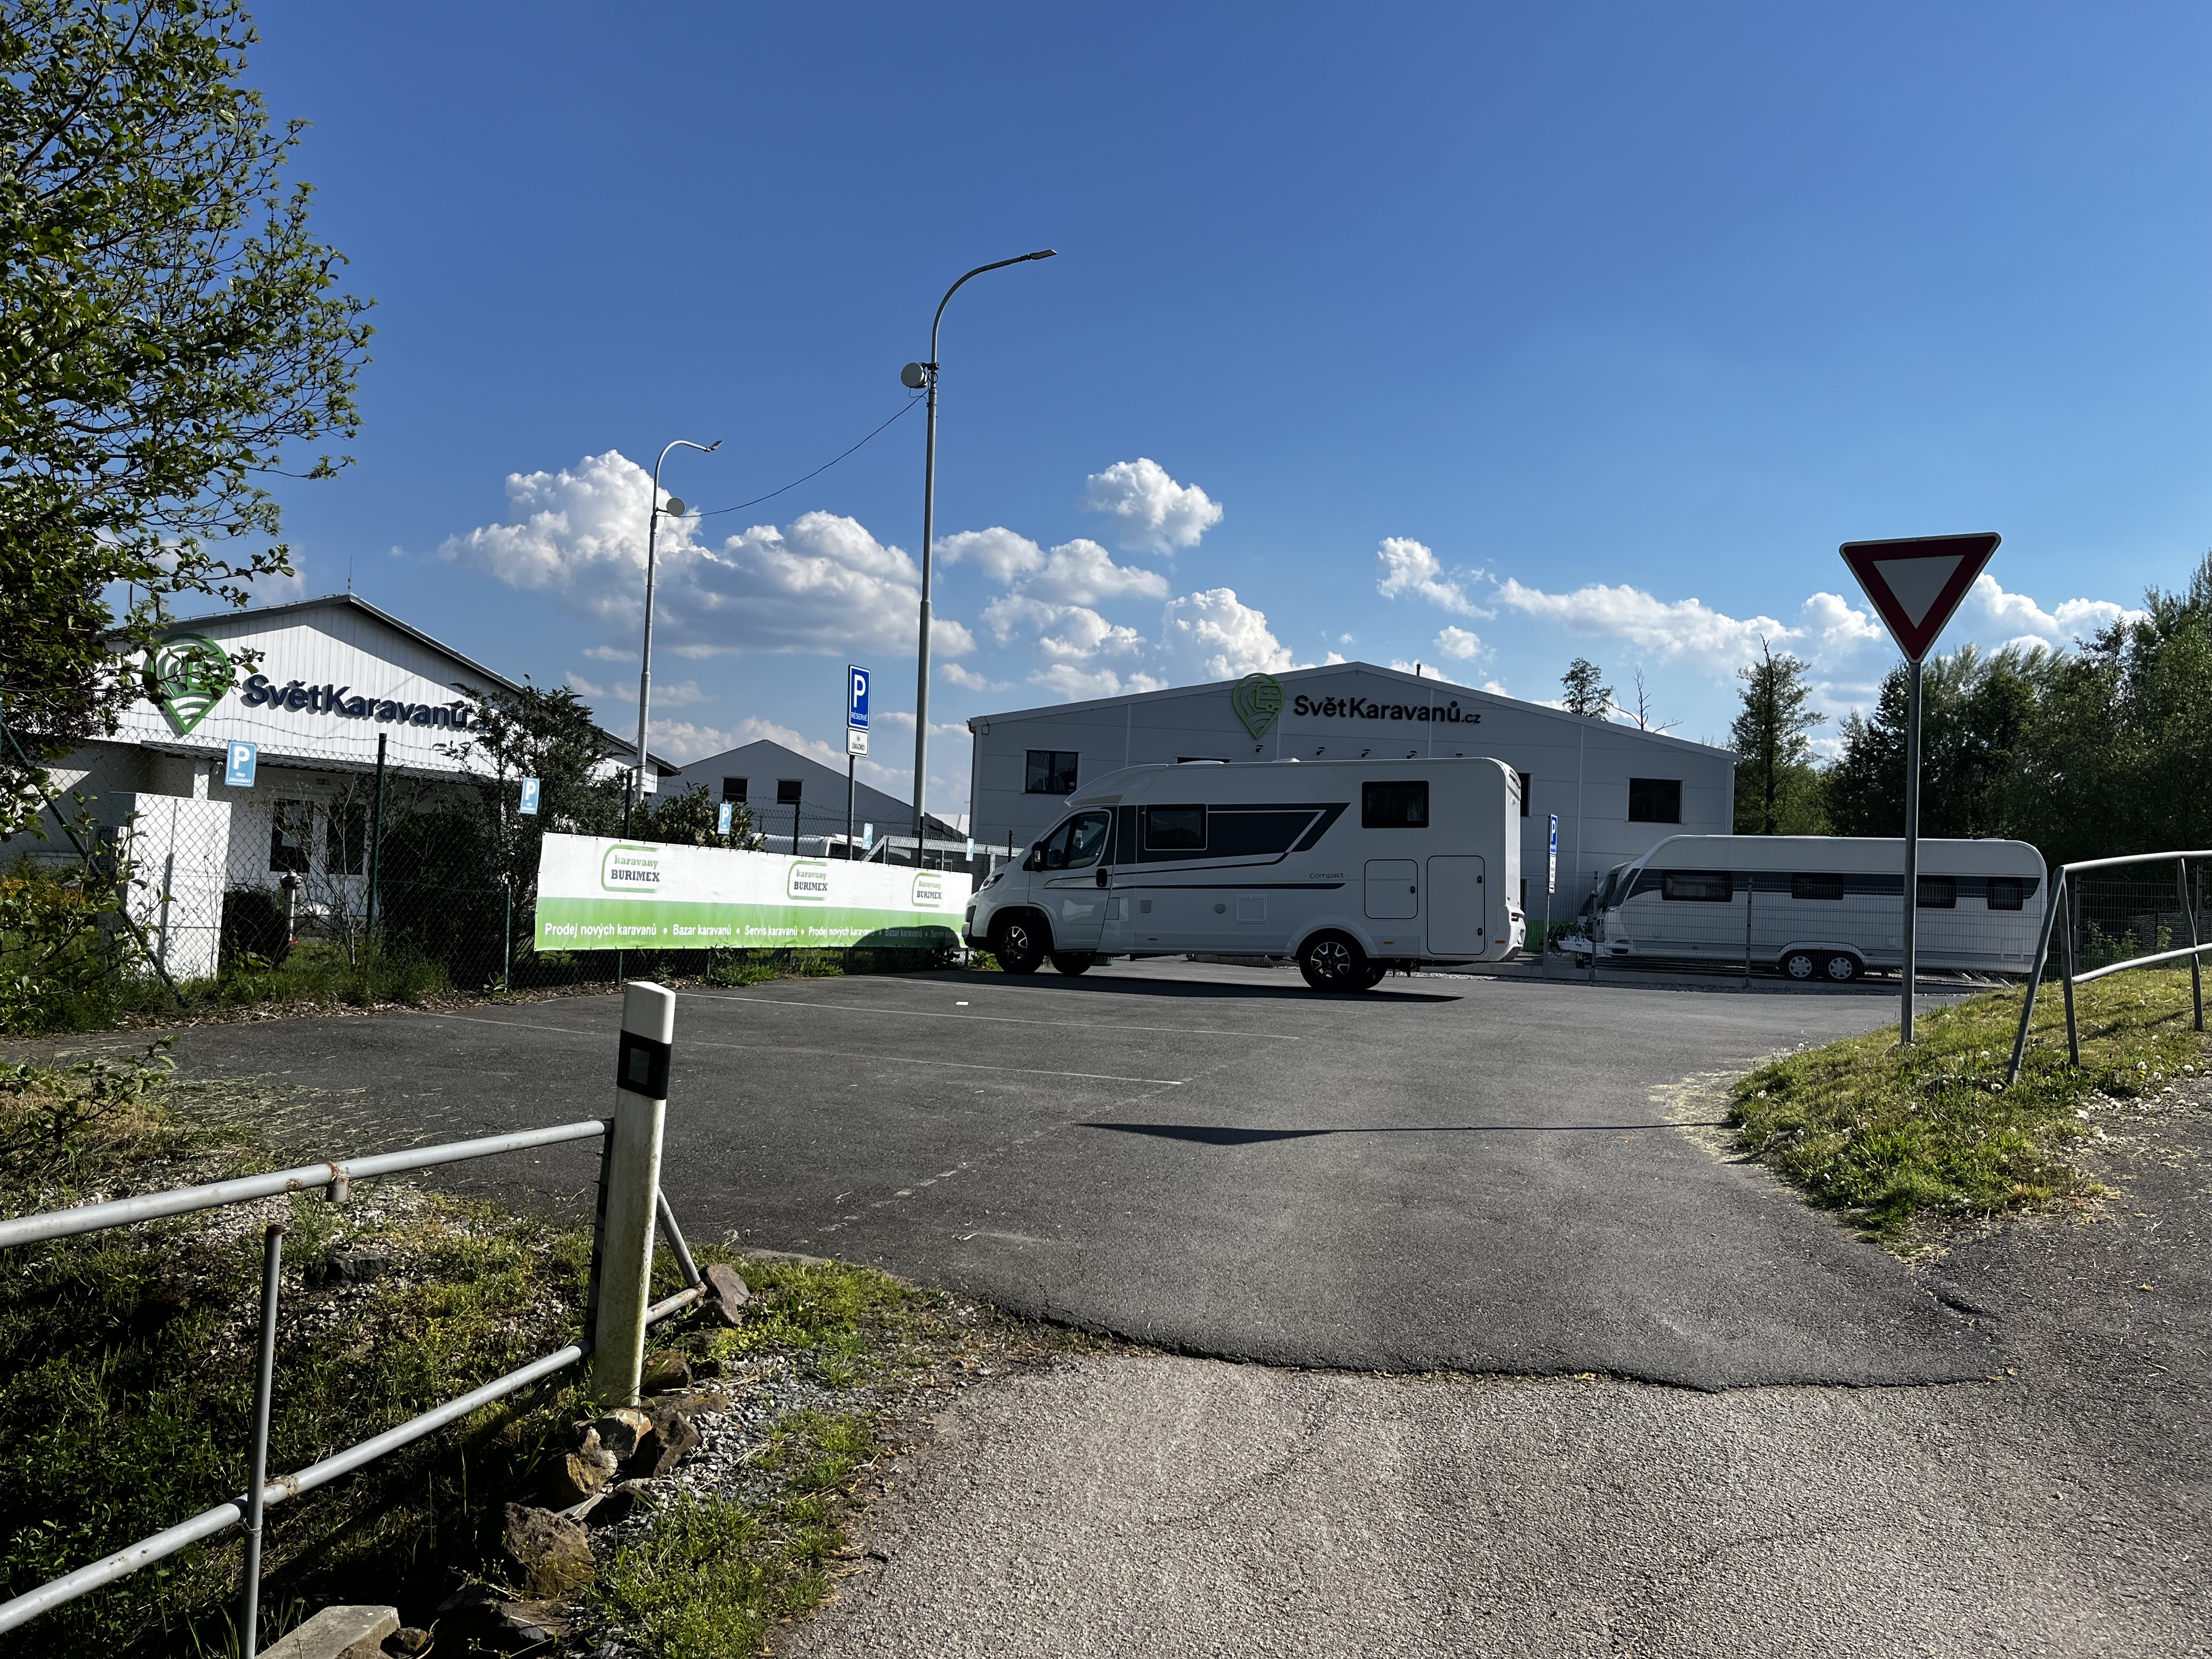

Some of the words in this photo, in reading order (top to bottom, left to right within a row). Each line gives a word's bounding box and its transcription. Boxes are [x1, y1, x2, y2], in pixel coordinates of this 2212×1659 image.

[854, 674, 866, 708] P
[246, 674, 487, 733] SvětKaravanů
[1294, 695, 1481, 724] SvětKaravanů.cz
[234, 746, 250, 769] P
[525, 781, 535, 800] P
[721, 806, 729, 823] P
[865, 826, 871, 839] P
[1551, 820, 1556, 841] P
[614, 855, 658, 870] karavany
[611, 869, 660, 882] BURIMEX
[797, 869, 827, 881] karavany
[794, 881, 828, 891] BURIMEX
[919, 880, 941, 890] karavany
[917, 890, 942, 899] BURIMEX
[545, 923, 578, 938] Prodej
[581, 923, 615, 938] nových
[617, 923, 657, 935] karavanů
[673, 924, 696, 935] Bazar
[698, 924, 731, 935] karavanů
[745, 925, 766, 935] Servis
[768, 926, 798, 936] karavanů
[809, 926, 828, 938] Prodej
[829, 926, 849, 938] nových
[850, 927, 875, 936] karavanů
[885, 928, 900, 936] Bazar
